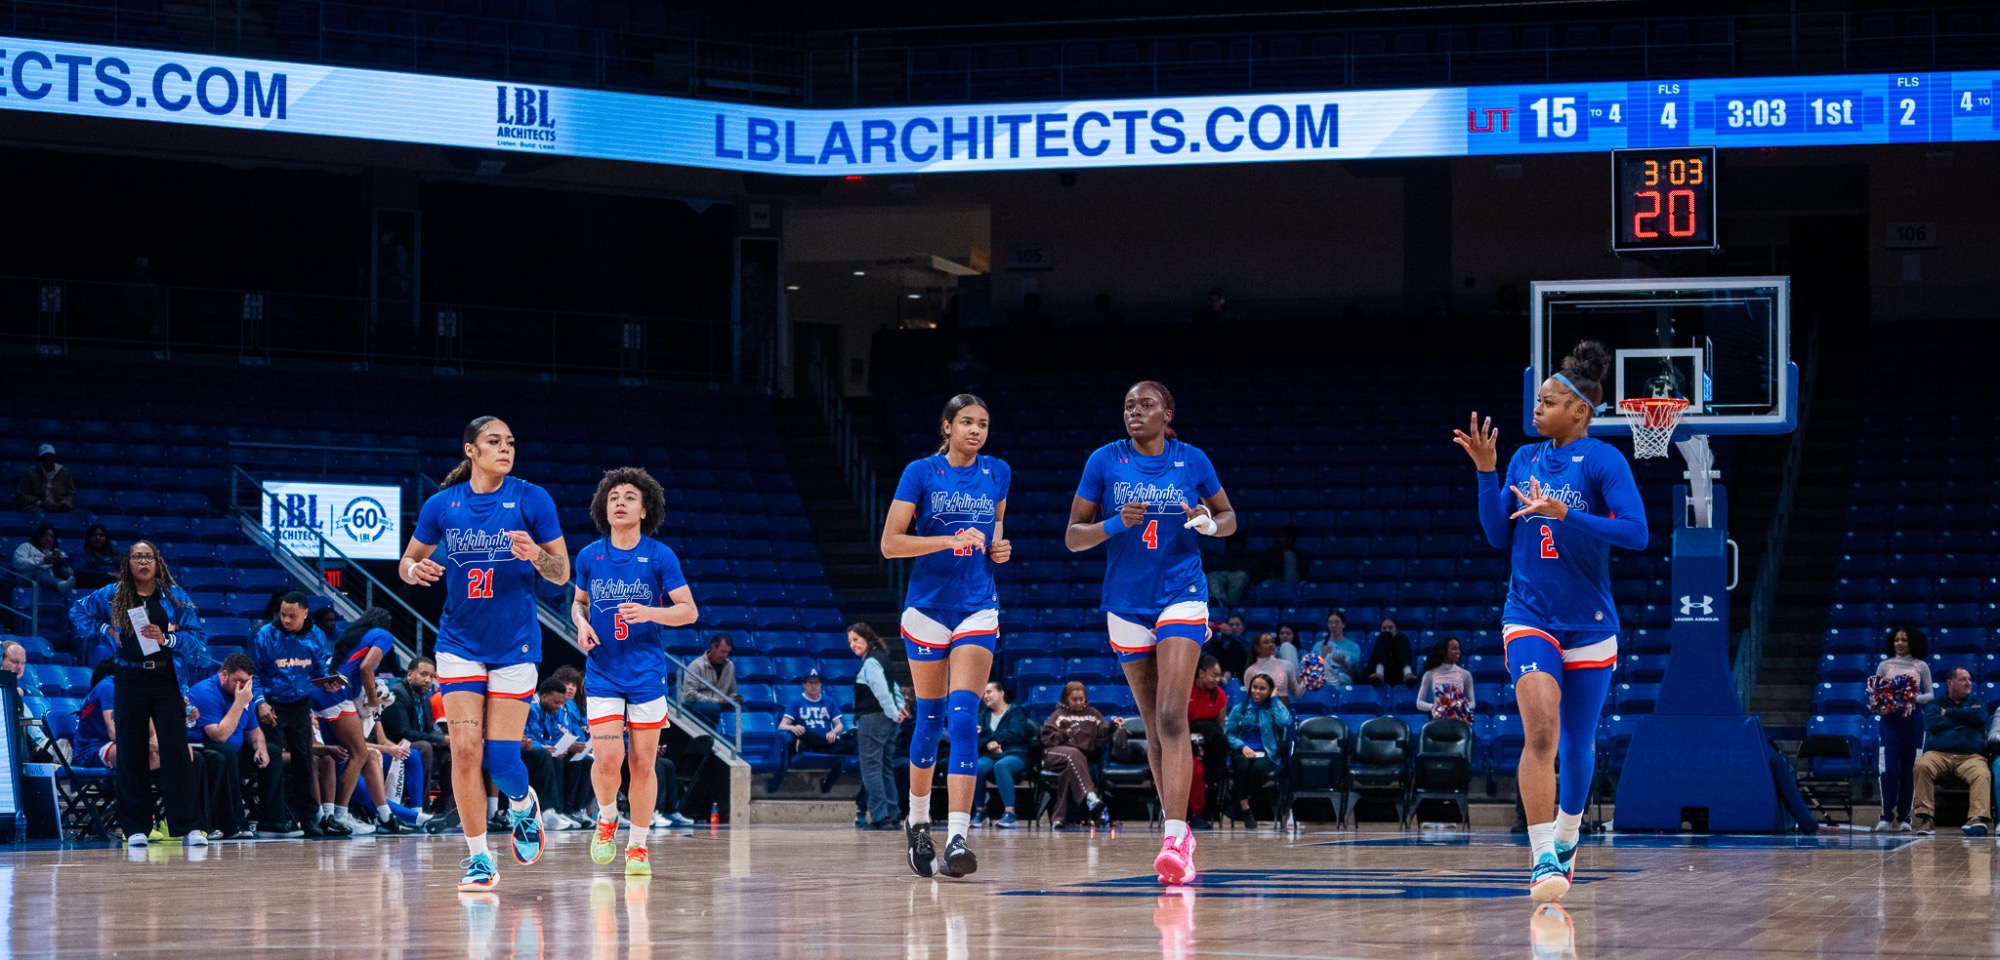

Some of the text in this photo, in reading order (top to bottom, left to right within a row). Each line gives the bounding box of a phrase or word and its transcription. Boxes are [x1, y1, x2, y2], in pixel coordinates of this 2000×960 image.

[0, 49, 288, 119] CTS.COM
[1658, 84, 1680, 95] FLS
[1897, 77, 1919, 88] FLS
[497, 86, 556, 129] LBL
[1590, 103, 1622, 123] TO 4
[1727, 99, 1787, 128] 3:03
[1811, 98, 1854, 126] 1st
[1900, 98, 1916, 126] 2
[1960, 91, 1990, 111] 4 TO
[1530, 97, 1577, 138] 15
[1660, 102, 1678, 129] 4
[497, 126, 556, 141] ARCHITECTS
[715, 103, 1339, 164] LBLARCHITECTS.COM
[1644, 159, 1703, 186] 3:03
[1634, 190, 1696, 238] 20
[1896, 226, 1926, 241] 106
[1016, 249, 1042, 263] 105
[270, 493, 323, 529] LBL
[352, 507, 378, 529] 60
[1142, 520, 1158, 549] 4
[1540, 525, 1559, 559] 2
[468, 568, 493, 598] 21
[614, 613, 629, 640] 5
[799, 706, 830, 720] UTA
